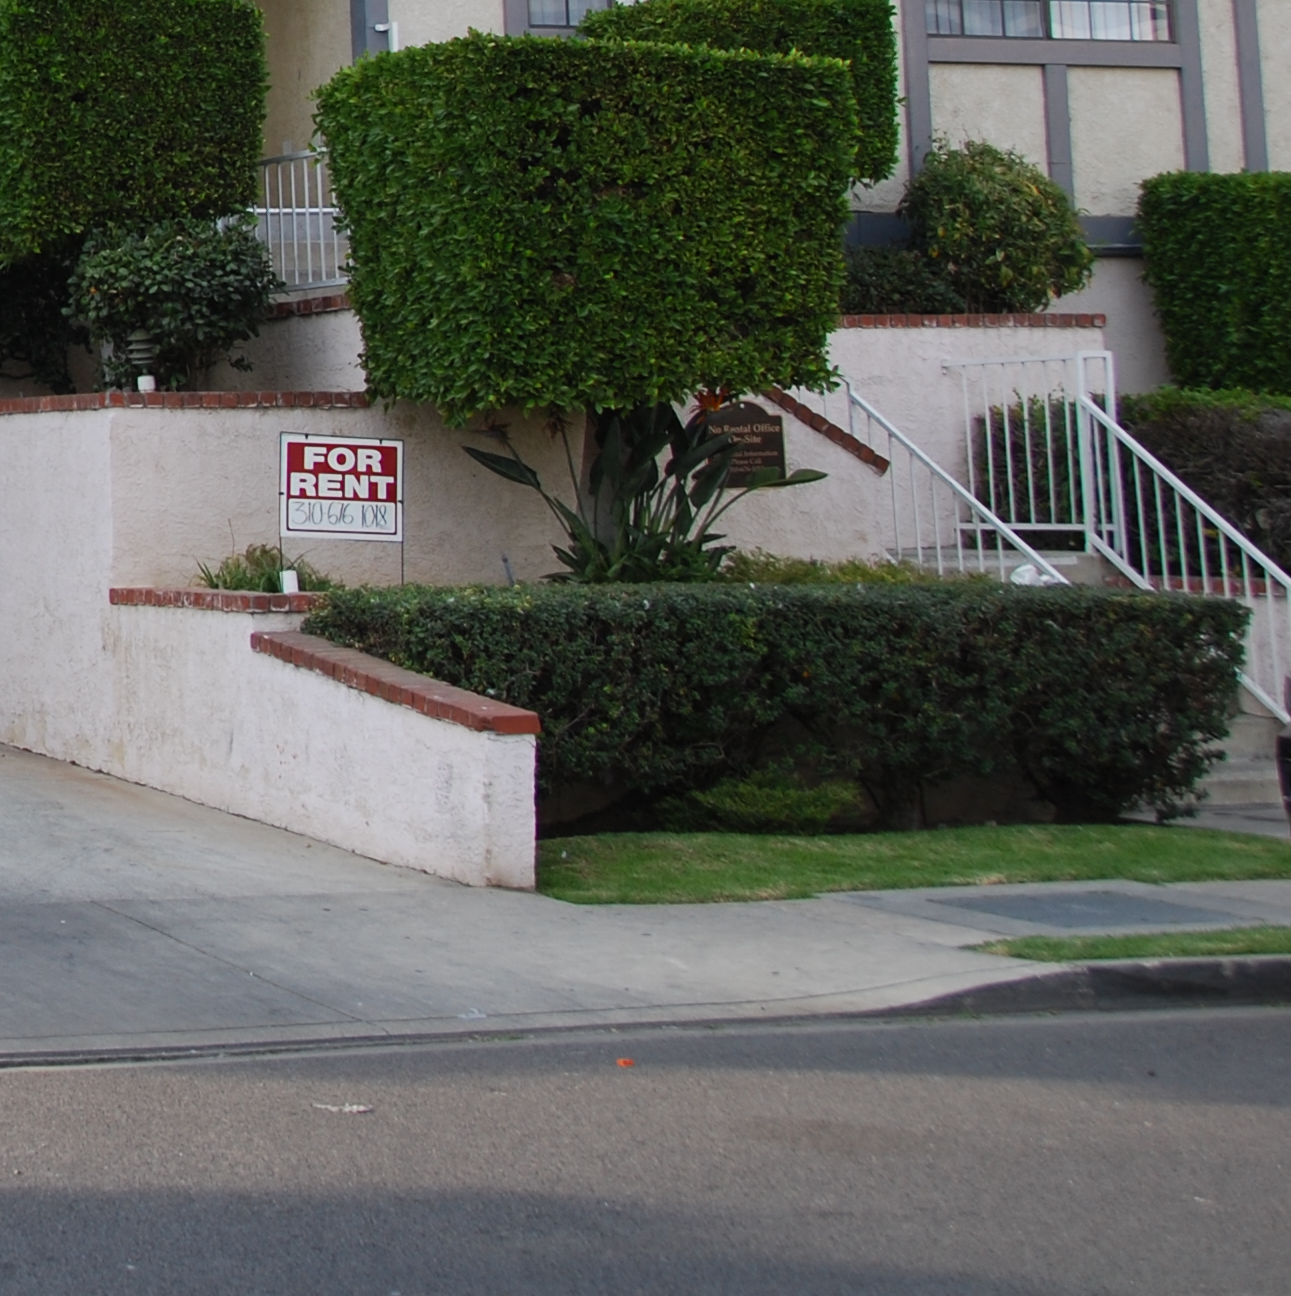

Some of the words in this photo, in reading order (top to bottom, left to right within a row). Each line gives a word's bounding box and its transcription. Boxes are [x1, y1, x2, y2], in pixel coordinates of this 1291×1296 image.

[708, 425, 721, 434] No
[724, 424, 751, 433] Rental
[753, 423, 780, 433] Office
[304, 446, 382, 473] FOR
[290, 472, 394, 499] RENT
